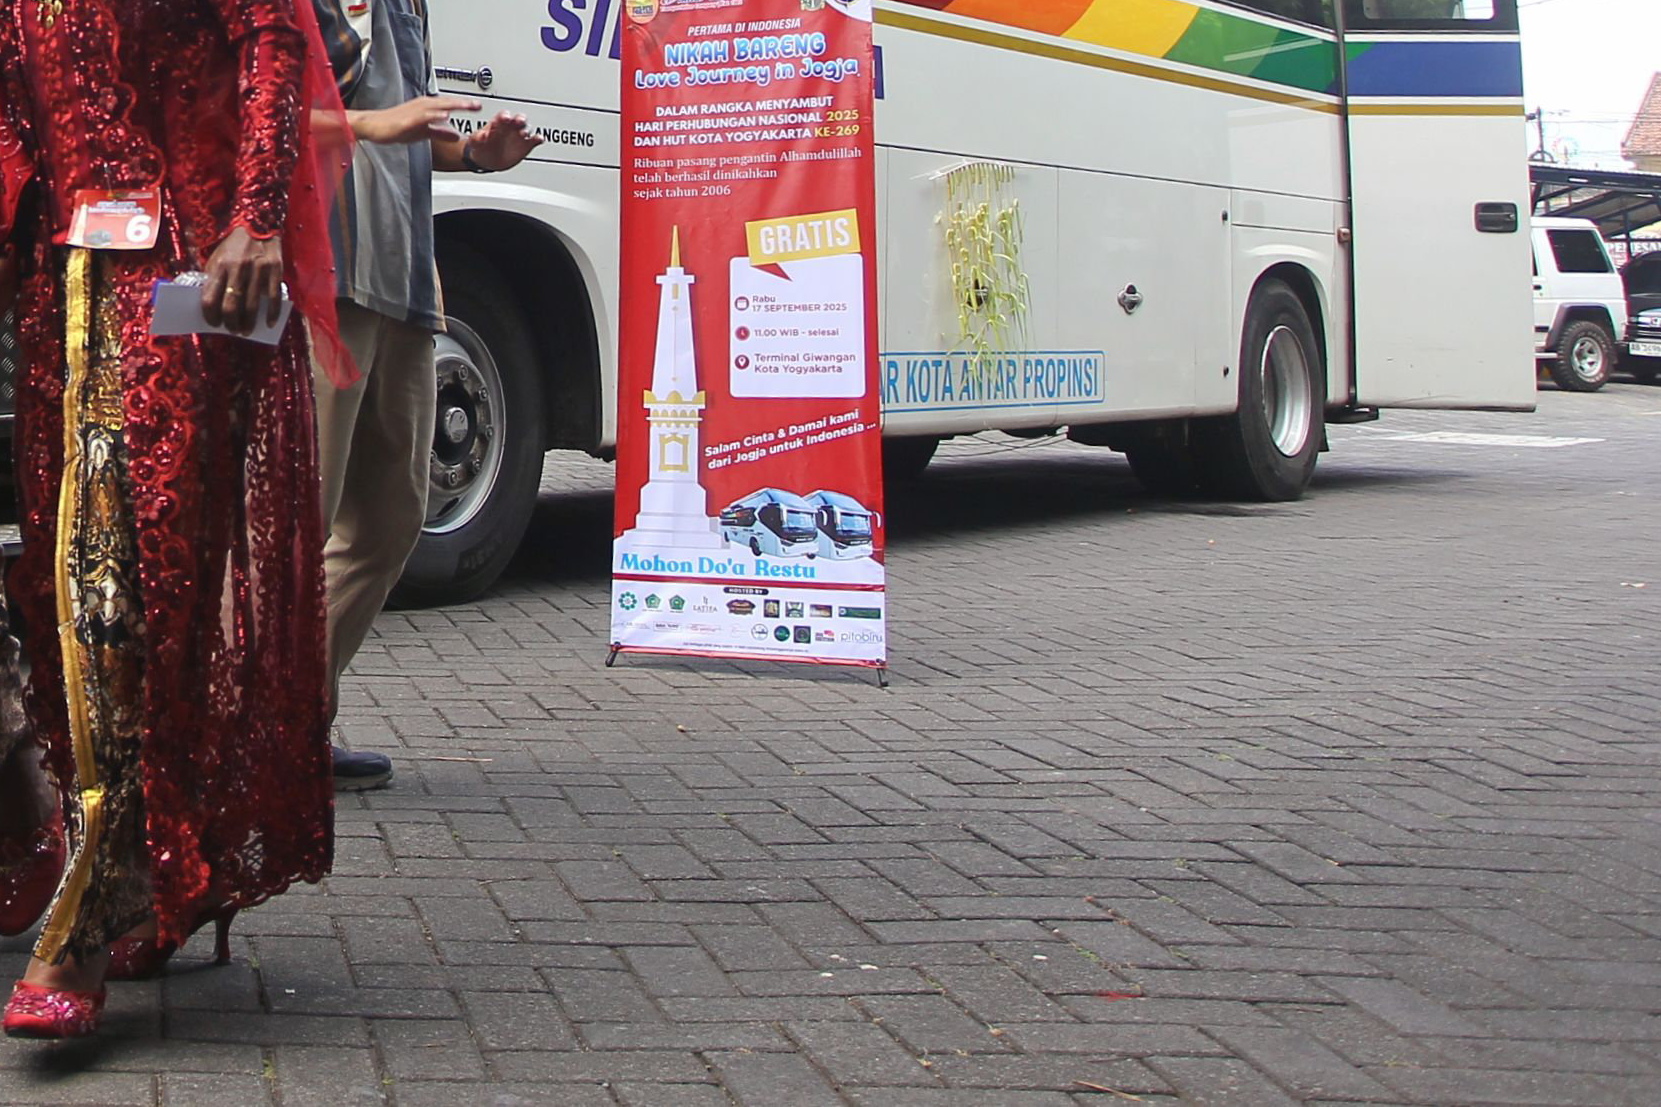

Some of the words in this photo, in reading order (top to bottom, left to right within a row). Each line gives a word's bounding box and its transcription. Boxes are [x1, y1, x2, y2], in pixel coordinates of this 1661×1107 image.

[687, 24, 733, 37] PERTAMA
[735, 23, 745, 34] DI
[748, 18, 802, 33] INDONESIA
[665, 39, 729, 67] NIKAH
[734, 32, 826, 61] BARENG
[634, 68, 680, 90] Love
[685, 63, 771, 87] Journey
[774, 61, 795, 79] in
[655, 104, 699, 117] DALAM
[700, 101, 754, 115] RANGKA
[755, 95, 834, 111] MENYAMBUT
[635, 121, 664, 132] HARI
[666, 115, 756, 132] PERHUBUNGAN
[758, 111, 823, 126] NASIONAL
[825, 109, 859, 122] 2025
[634, 136, 660, 147] DAN
[663, 134, 688, 146] HUT
[689, 132, 723, 144] KOTA
[724, 127, 813, 143] YOGYAKARTA
[814, 124, 860, 137] KE-269
[634, 156, 674, 168] Ribuan
[676, 157, 717, 170] pasang
[719, 152, 777, 167] pengantin
[779, 146, 862, 162] Alhamdulillah
[633, 172, 662, 183] telah
[664, 169, 710, 182] berhasil
[712, 167, 778, 180] dinikahkan
[633, 187, 663, 201] sejak
[665, 186, 699, 198] tahun
[700, 184, 732, 197] 2006
[125, 214, 152, 243] 6
[759, 216, 851, 256] GRATIS
[752, 295, 776, 303] Rabu
[752, 304, 762, 312] 17
[763, 303, 821, 313] SEPTEMBER
[823, 302, 848, 312] 2025
[754, 328, 778, 337] 11.00
[779, 328, 800, 337] WIB
[807, 327, 840, 337] selesai
[754, 352, 800, 363] Terminal
[802, 352, 857, 365] Giwangan
[754, 364, 780, 374] Kota
[782, 364, 843, 376] Yogyakarta
[905, 359, 955, 404] KOTA
[1022, 357, 1098, 399] PROPINSI
[704, 441, 741, 458] Salam
[743, 432, 775, 448] Cinta
[777, 428, 787, 438] &
[788, 418, 827, 436] Damai
[828, 408, 860, 426] kami
[707, 454, 732, 470] dari
[734, 447, 767, 465] Jogja
[769, 437, 804, 455] untuk
[806, 422, 865, 446] Indonesia
[620, 552, 694, 574] Mohon
[698, 556, 745, 576] Do'a
[755, 559, 817, 579] Restu
